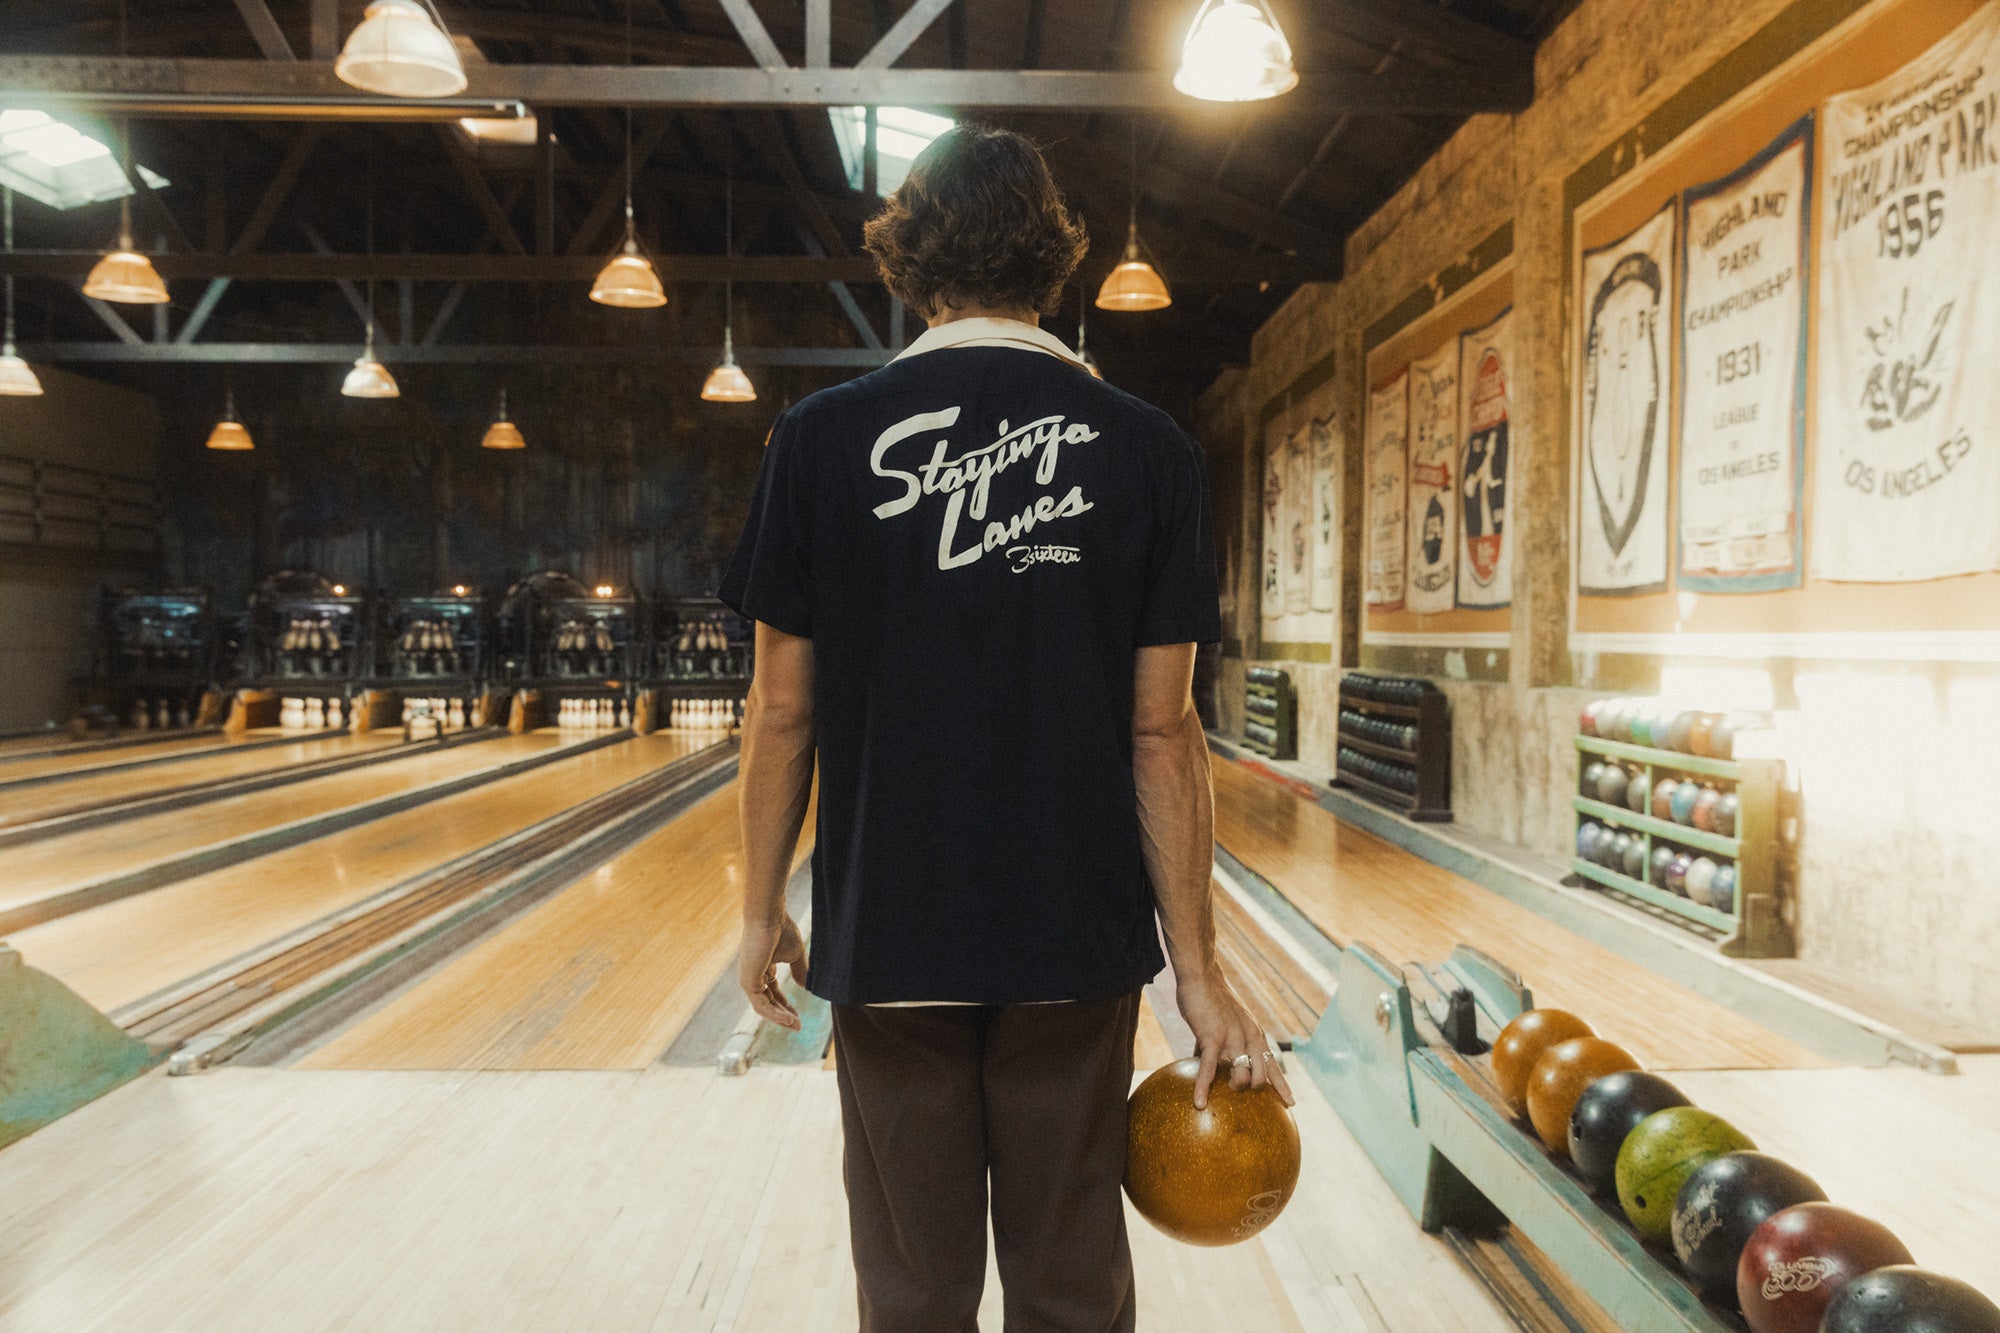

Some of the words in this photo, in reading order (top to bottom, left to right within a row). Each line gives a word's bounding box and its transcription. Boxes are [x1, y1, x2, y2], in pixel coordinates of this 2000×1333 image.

[1701, 191, 1787, 254] HIGHLAND
[1878, 189, 1945, 259] 1956
[1717, 240, 1762, 279] PARK
[1688, 267, 1793, 330] CHAMPIONSHIP
[1717, 341, 1761, 385] 1931
[1712, 403, 1759, 431] LEAGUE
[938, 486, 1094, 570] Lanes
